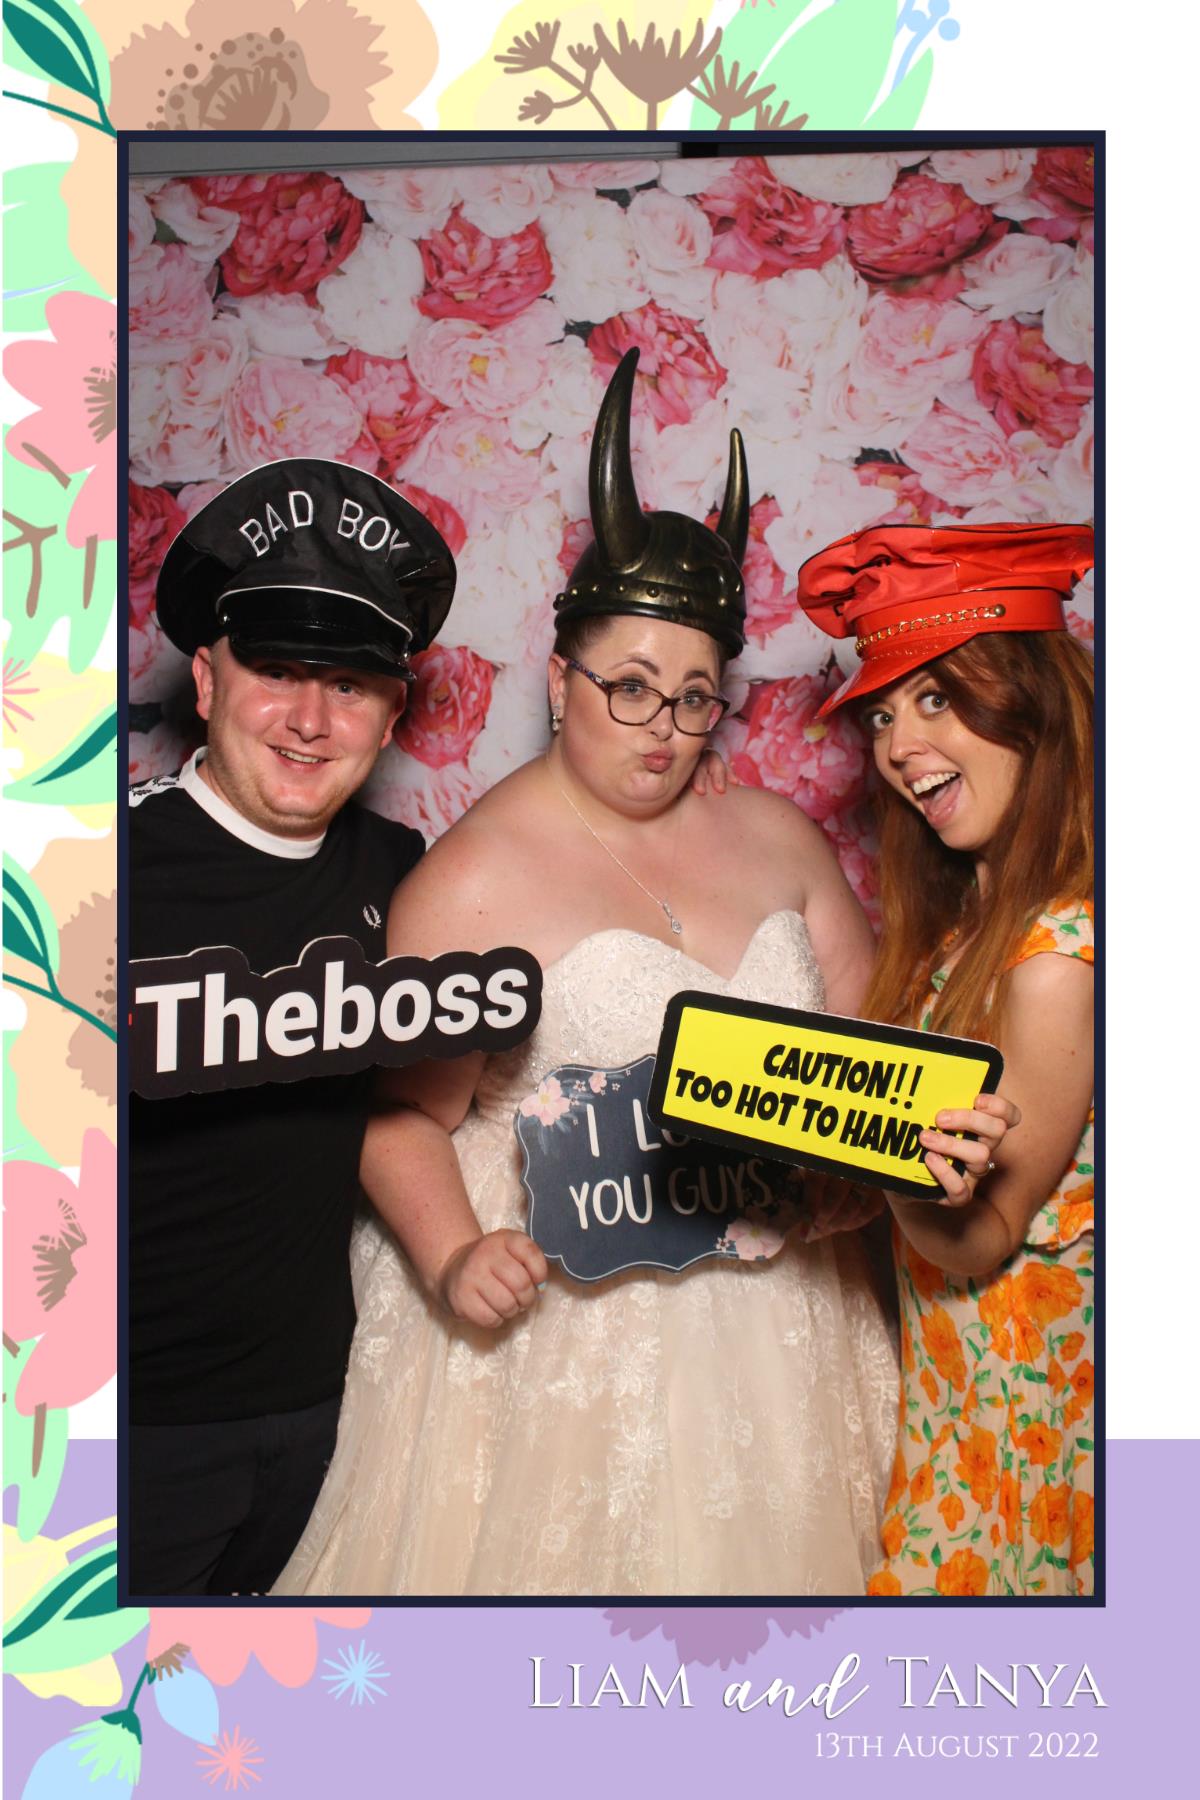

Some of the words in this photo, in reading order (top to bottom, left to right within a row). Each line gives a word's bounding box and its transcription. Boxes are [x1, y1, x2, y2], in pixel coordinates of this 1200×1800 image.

[239, 490, 314, 557] BAD
[337, 498, 409, 562] BOY
[135, 960, 529, 1074] Theboss
[675, 1068, 729, 1109] TOO
[735, 1084, 799, 1127] HOT
[800, 1098, 839, 1138] TO
[763, 1043, 924, 1110] CAUTION!!
[586, 1103, 600, 1158] I
[569, 1173, 654, 1231] YOU
[667, 1157, 774, 1216] GUYS
